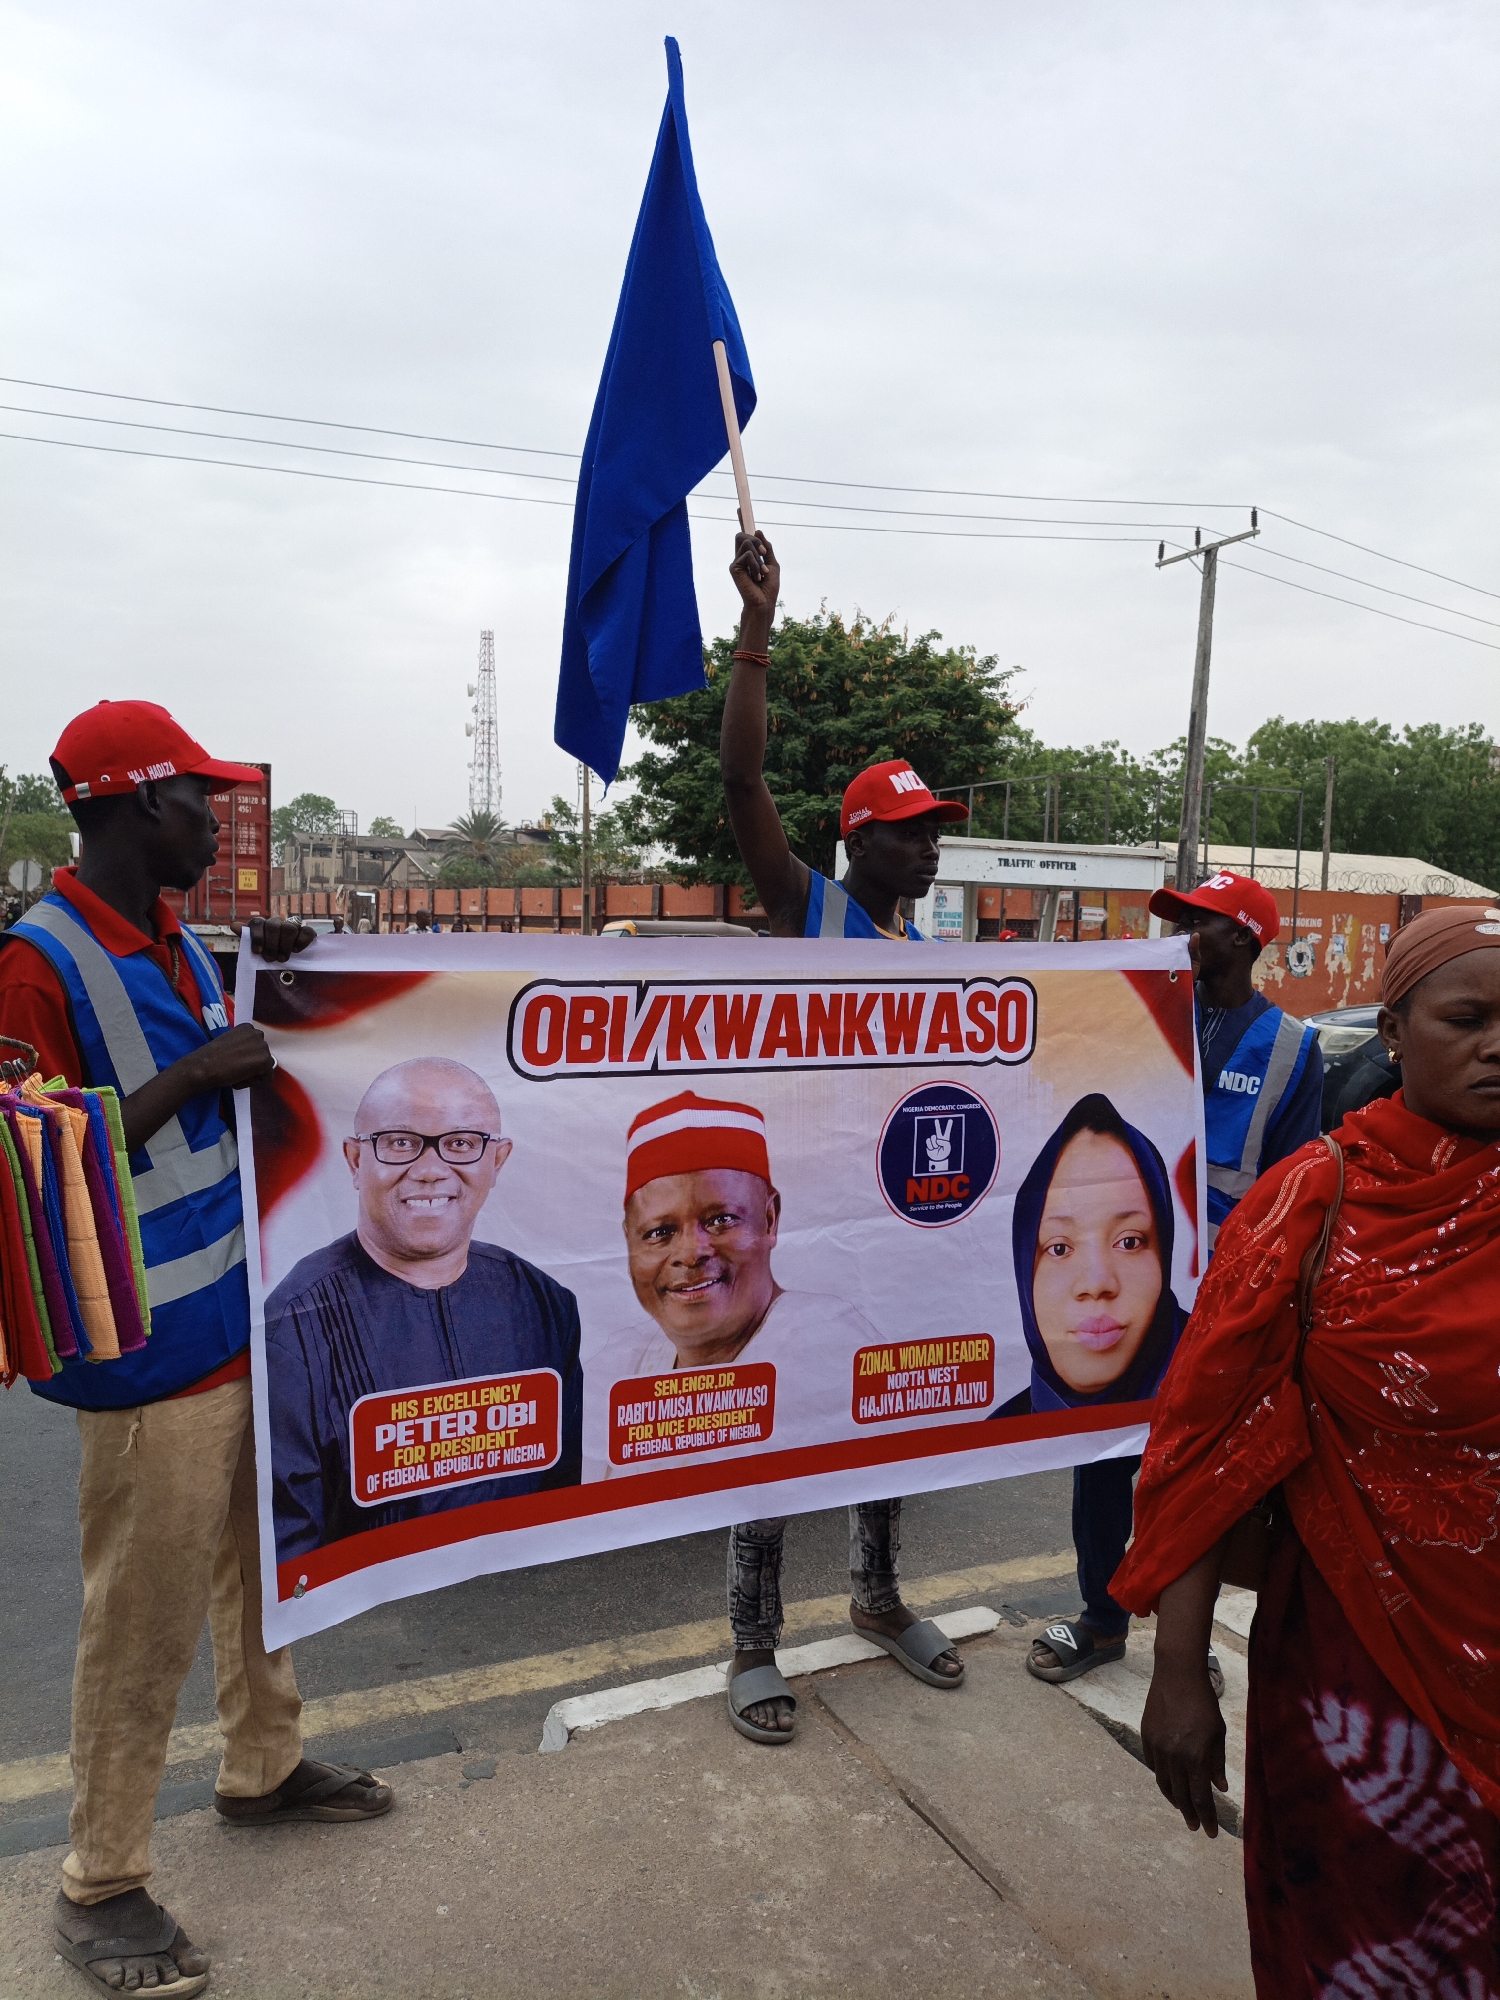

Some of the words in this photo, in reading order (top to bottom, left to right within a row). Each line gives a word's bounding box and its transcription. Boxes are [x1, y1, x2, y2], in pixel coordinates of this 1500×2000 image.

[889, 770, 929, 794] ND
[998, 858, 1036, 868] TRAFFIC
[1040, 860, 1077, 870] OFFICER
[1279, 916, 1290, 927] NO
[202, 1003, 229, 1031] ND
[521, 991, 1029, 1067] OBI/KWANKWASO
[1218, 1070, 1260, 1095] NDC
[906, 1174, 970, 1203] NDC
[859, 1349, 896, 1376] ZONAL
[899, 1343, 943, 1370] WOMAN
[946, 1339, 990, 1364] LEADER
[887, 1370, 925, 1390] NORTH
[928, 1366, 960, 1385] WEST
[391, 1399, 418, 1421] HIS
[424, 1383, 522, 1415] EXCELLENCY
[617, 1401, 656, 1427] RABI'U
[658, 1395, 693, 1421] MUSA
[696, 1385, 768, 1415] KWANKWASO
[859, 1391, 905, 1419] HAJIYA
[906, 1385, 951, 1411] HADIZA
[954, 1381, 988, 1406] ALIYU
[375, 1410, 477, 1452] PETER
[487, 1400, 537, 1431] OBI
[622, 1443, 633, 1460] OF
[635, 1437, 673, 1457] FEDERAL
[675, 1431, 716, 1451] REPUBLIC
[717, 1429, 728, 1443] OF
[729, 1422, 761, 1442] NIGERIA
[629, 1425, 653, 1442] FOR
[657, 1419, 685, 1438] VICE
[688, 1408, 756, 1432] PRESIDENT
[394, 1446, 426, 1468] FOR
[430, 1429, 518, 1461] PRESIDENT
[367, 1474, 380, 1494] OF
[382, 1464, 431, 1490] FEDERAL
[434, 1453, 484, 1479] REPUBLIC
[487, 1451, 500, 1468] OF
[503, 1443, 546, 1466] NIGERIA
